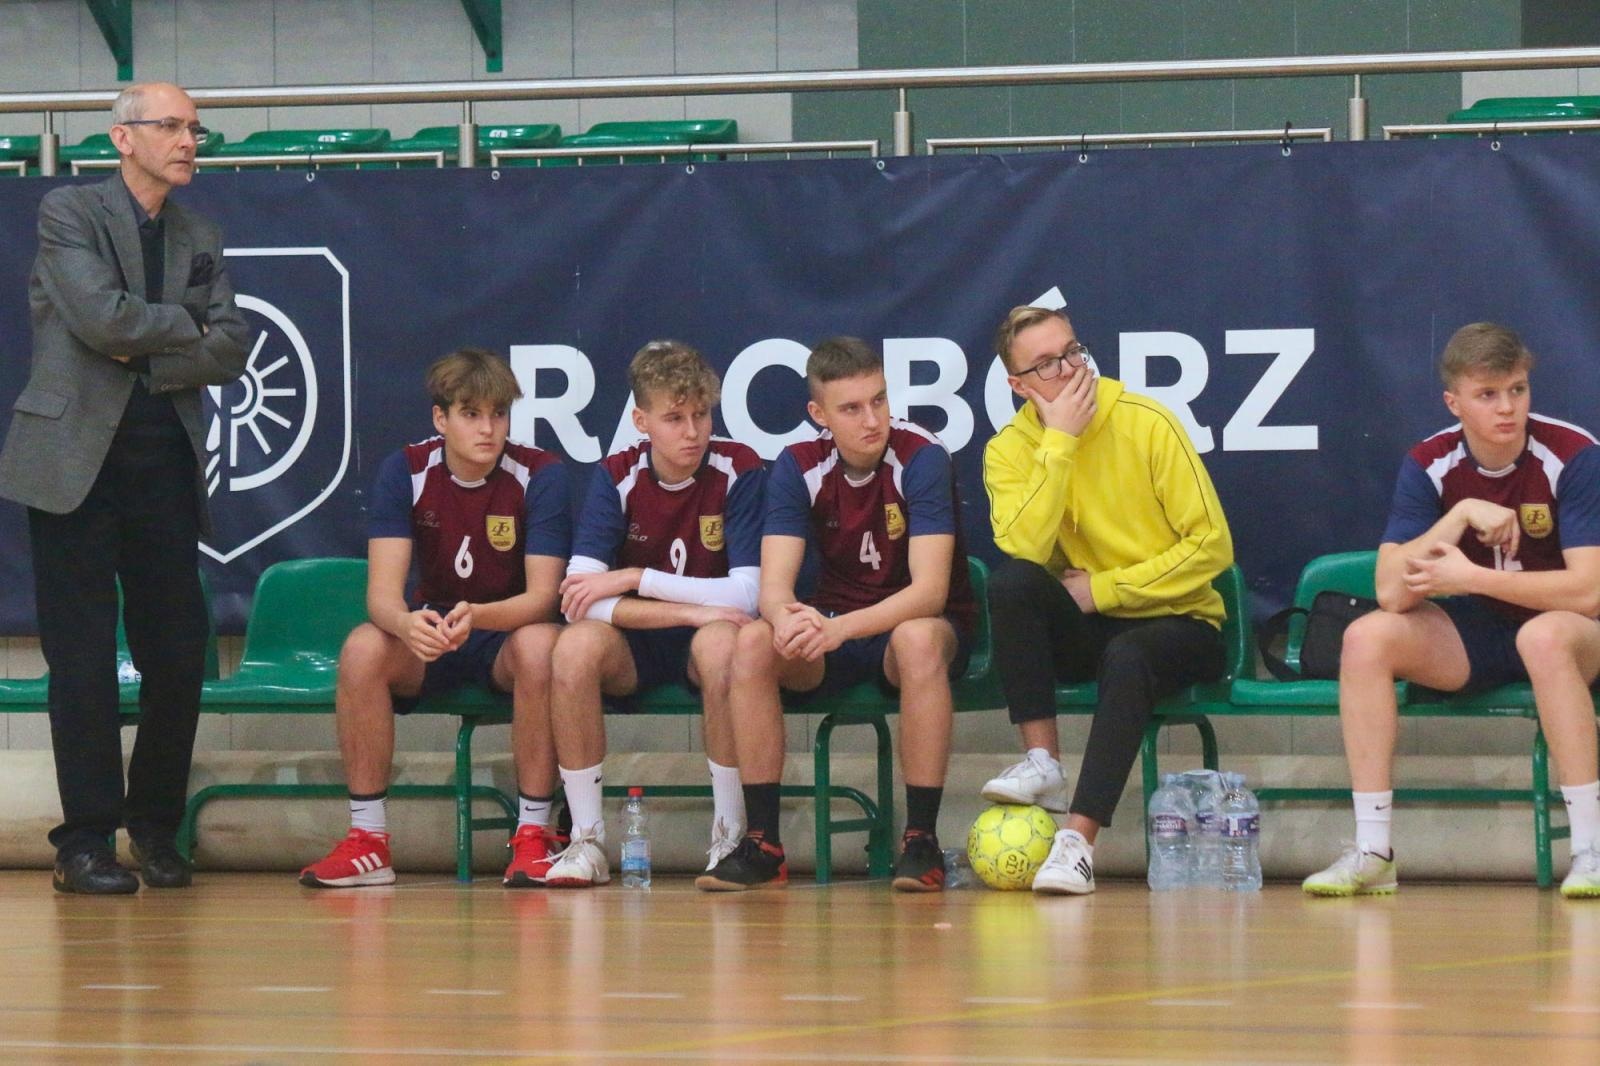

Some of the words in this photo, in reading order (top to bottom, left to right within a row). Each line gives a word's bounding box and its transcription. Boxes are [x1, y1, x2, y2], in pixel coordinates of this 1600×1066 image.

[509, 286, 1318, 464] RCBRZ
[454, 535, 474, 579] 6
[670, 537, 687, 577] 9
[859, 530, 882, 571] 4
